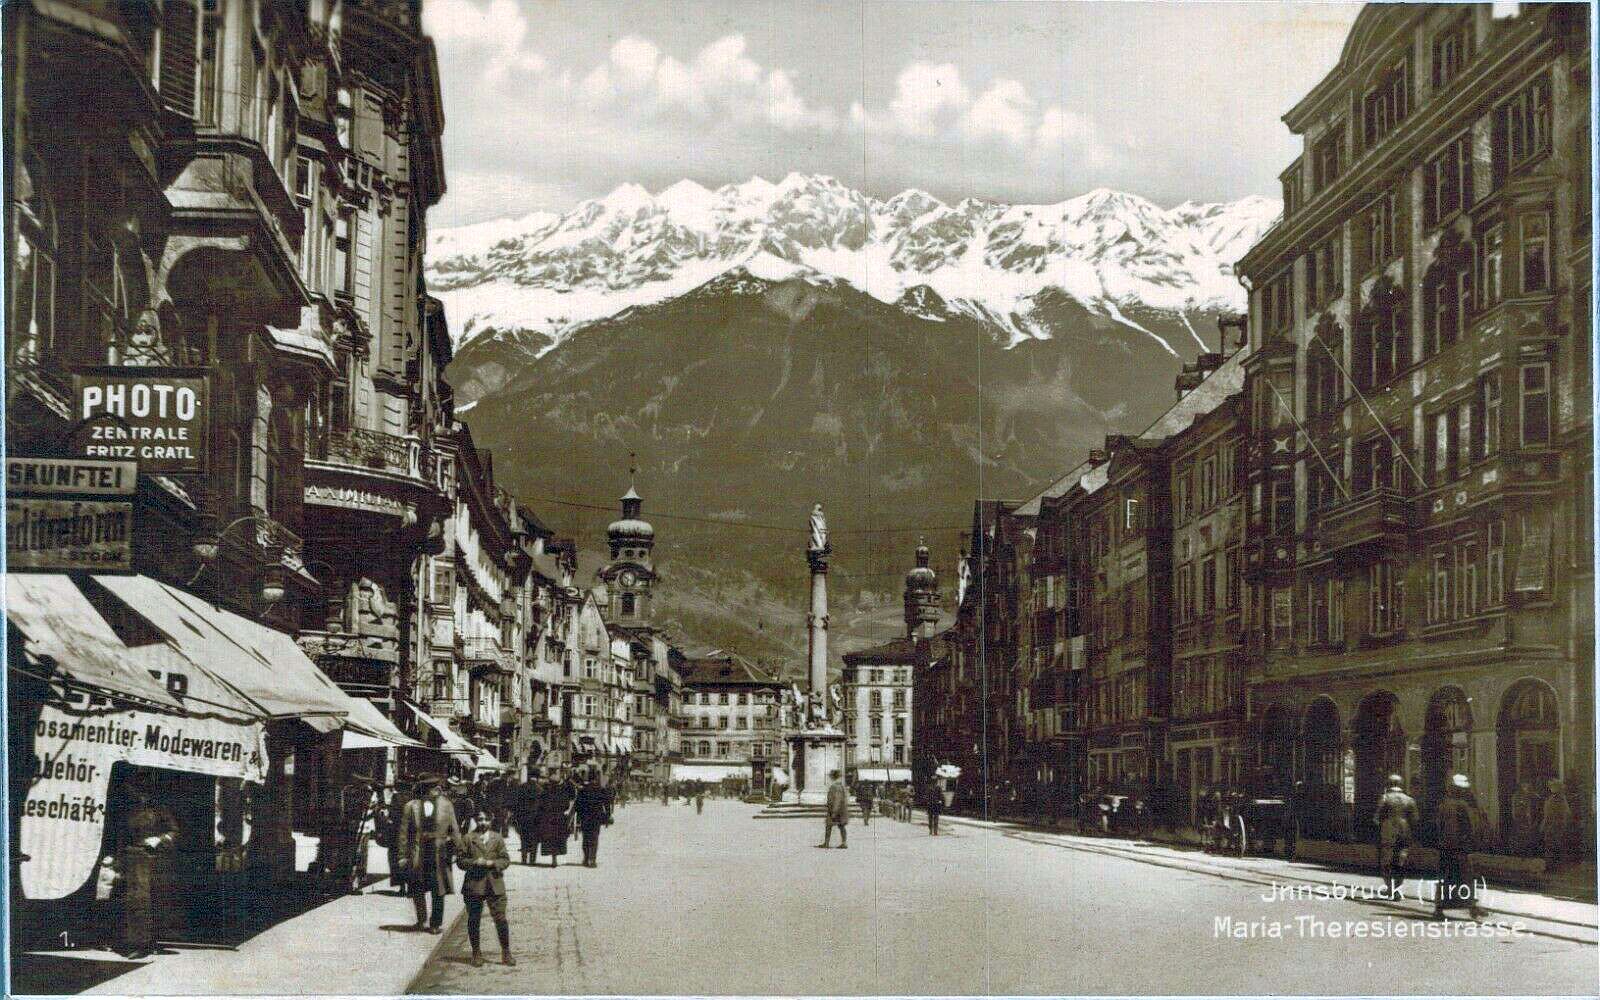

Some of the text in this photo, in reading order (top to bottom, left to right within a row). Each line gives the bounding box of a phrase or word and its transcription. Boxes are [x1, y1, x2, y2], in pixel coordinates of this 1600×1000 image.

[82, 383, 195, 420] PHOTO
[91, 426, 188, 440] ZENTRALE
[86, 445, 195, 459] FRITZ GRATL
